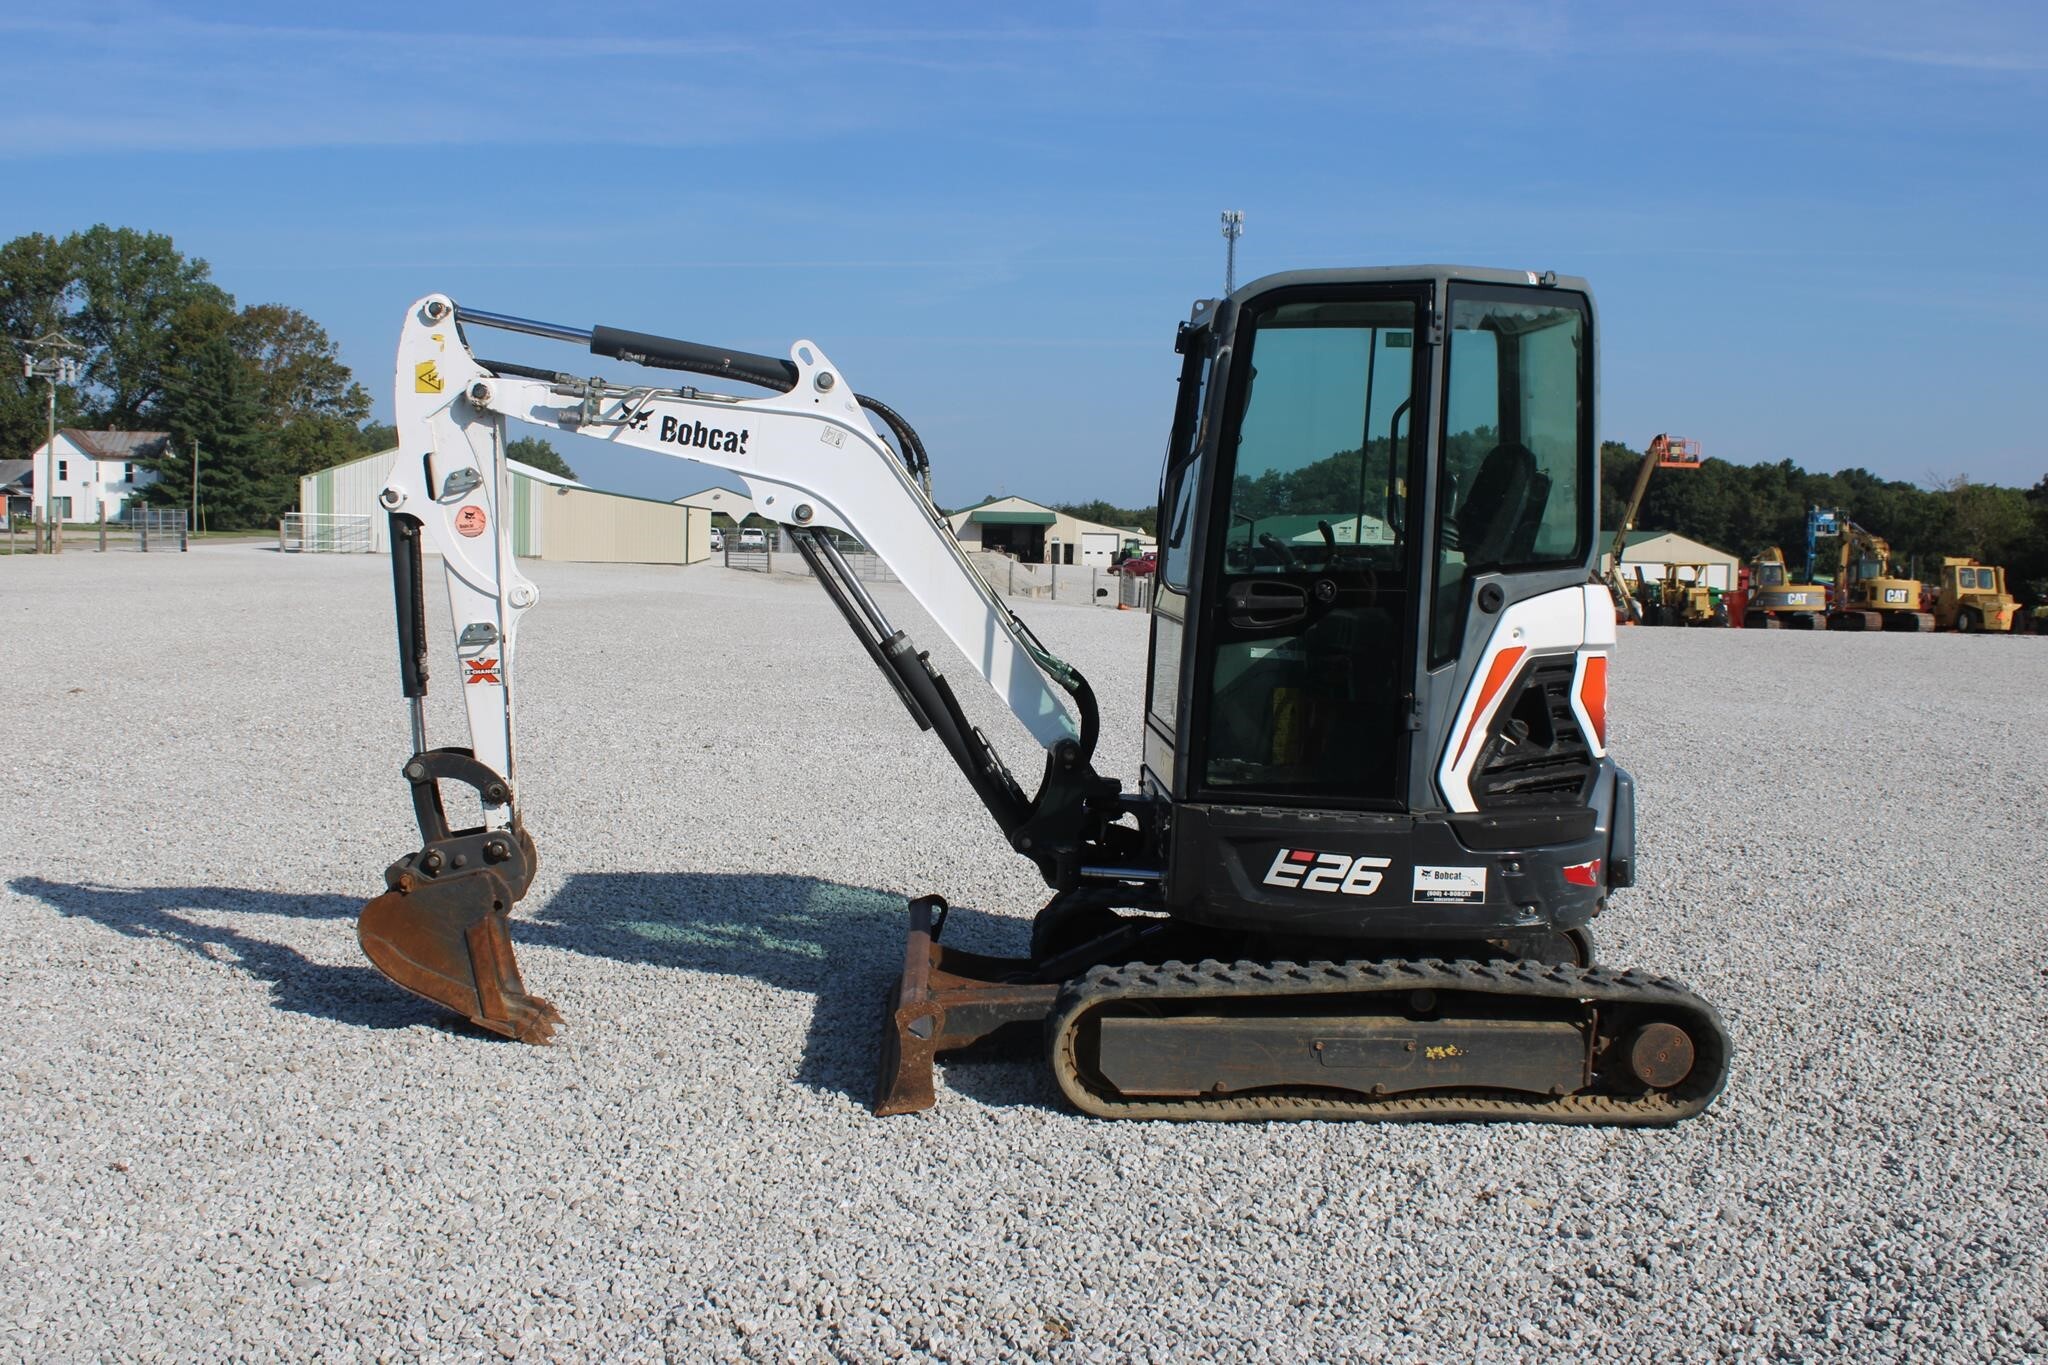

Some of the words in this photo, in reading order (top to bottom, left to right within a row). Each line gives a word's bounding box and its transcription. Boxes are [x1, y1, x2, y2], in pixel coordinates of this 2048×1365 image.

[660, 415, 749, 455] Bobcat
[1787, 593, 1808, 605] CAT
[1886, 589, 1907, 603] CAT
[1262, 848, 1392, 896] E26
[1434, 871, 1462, 880] Bobcat
